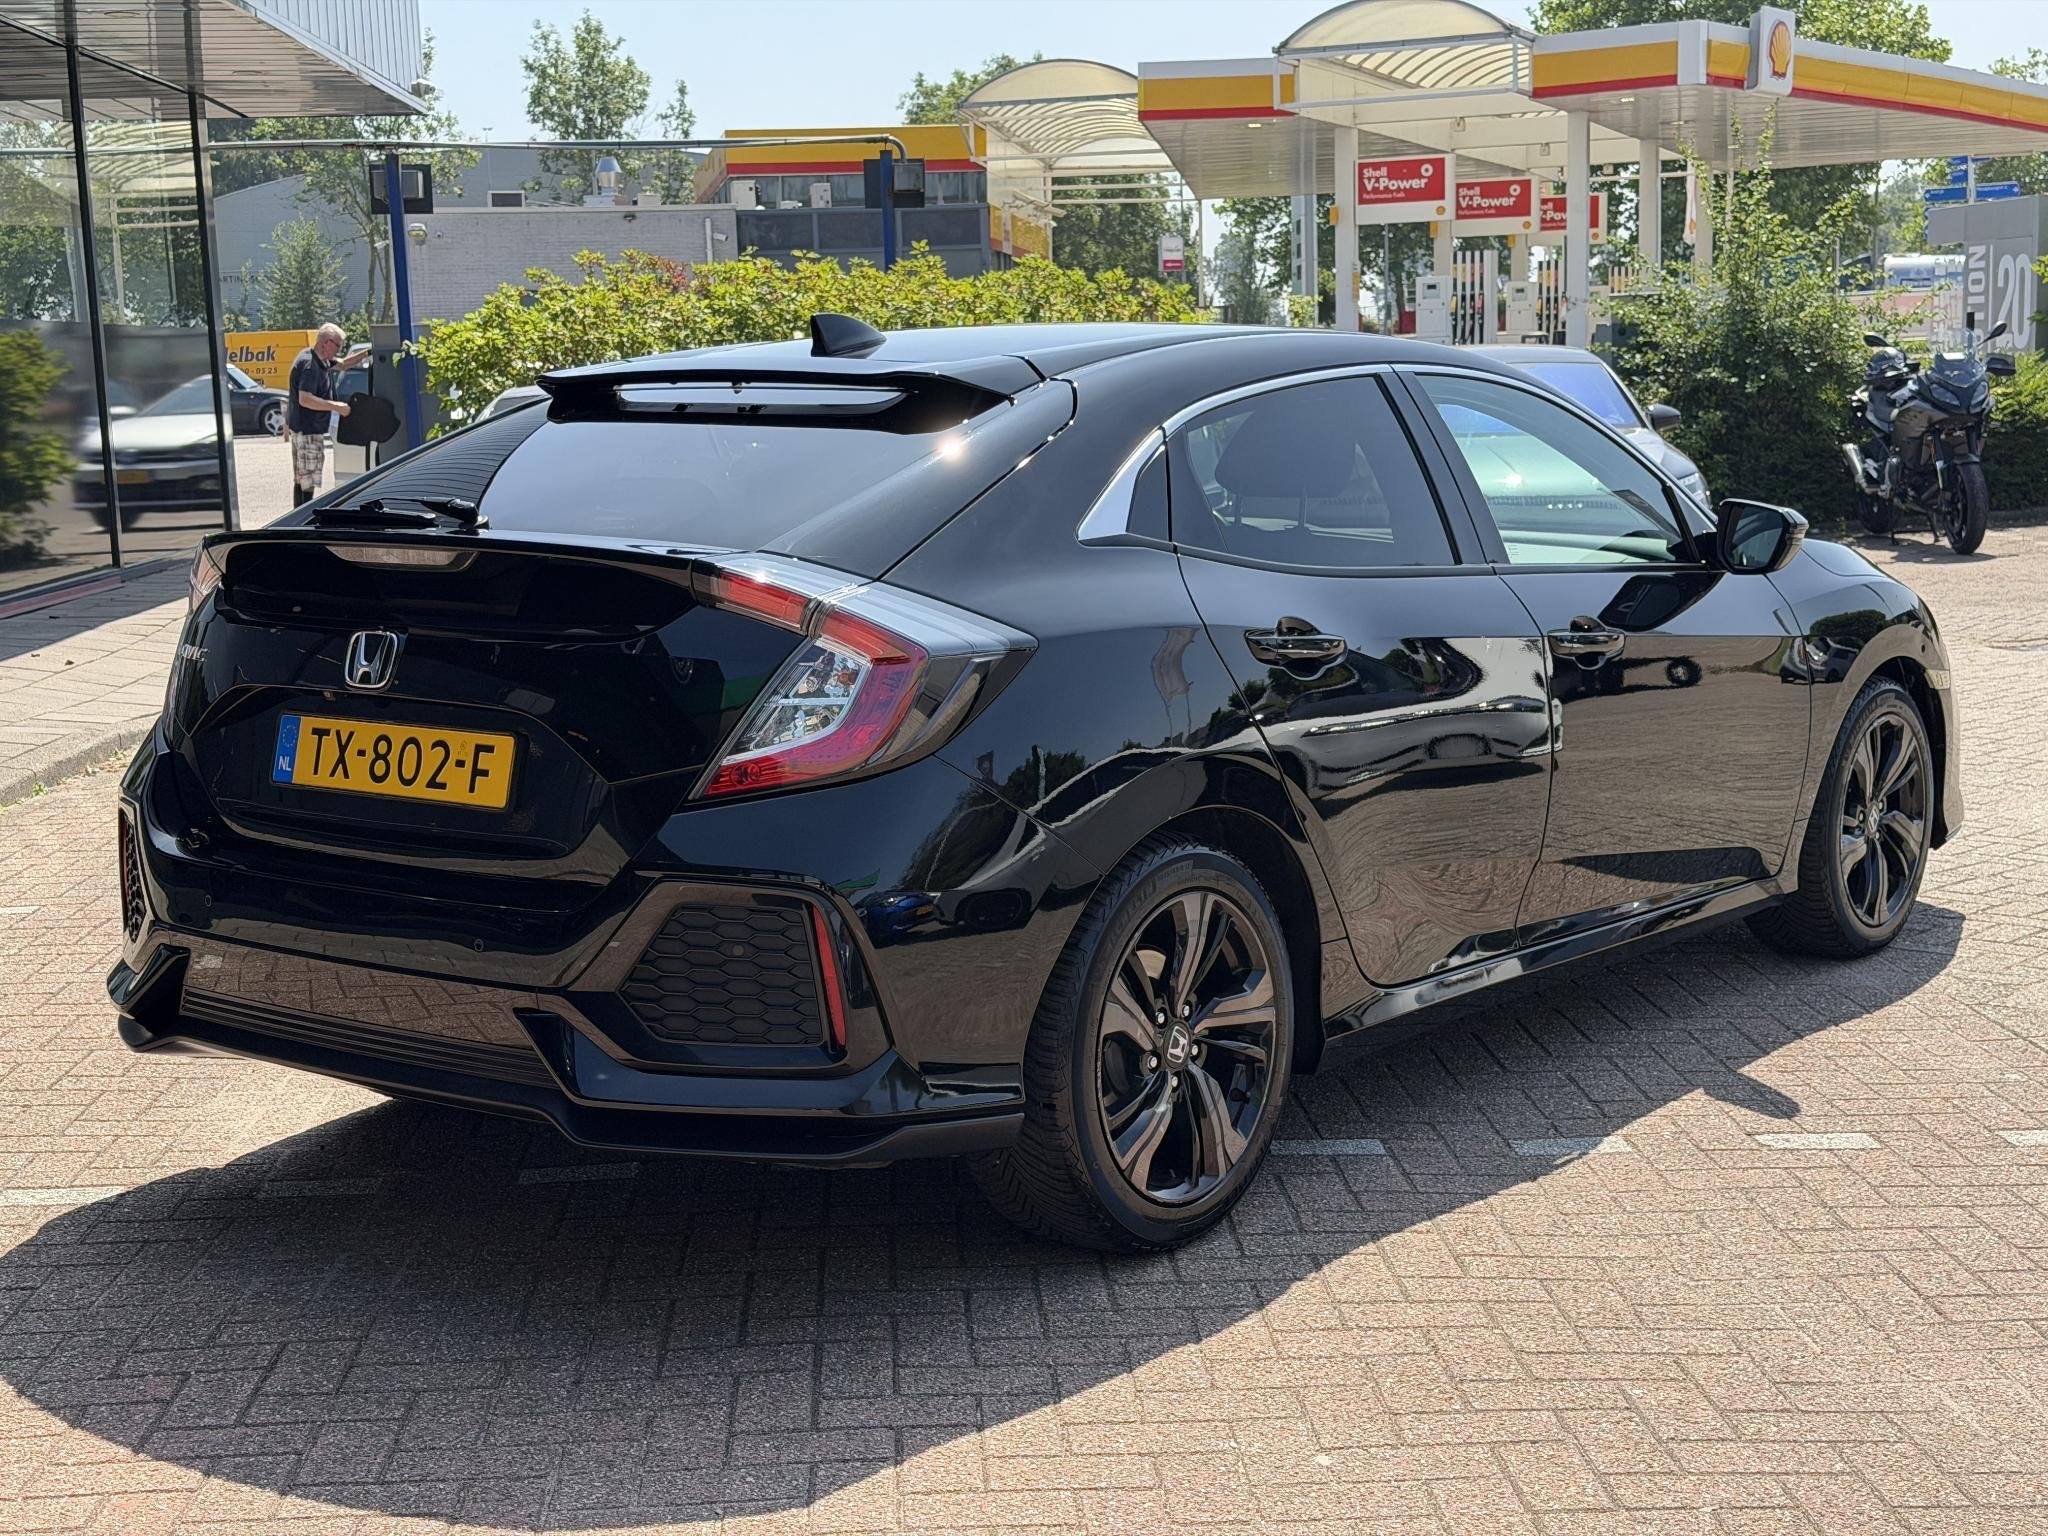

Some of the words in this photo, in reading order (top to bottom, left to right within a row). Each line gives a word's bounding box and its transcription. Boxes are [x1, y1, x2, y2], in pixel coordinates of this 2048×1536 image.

[1362, 166, 1388, 178] Shell
[1362, 177, 1429, 192] V-Power
[1458, 186, 1481, 197] Shell
[1458, 196, 1516, 208] V-Power
[1997, 253, 2033, 350] 20
[278, 755, 293, 772] NL
[311, 727, 496, 794] TX-802-F
